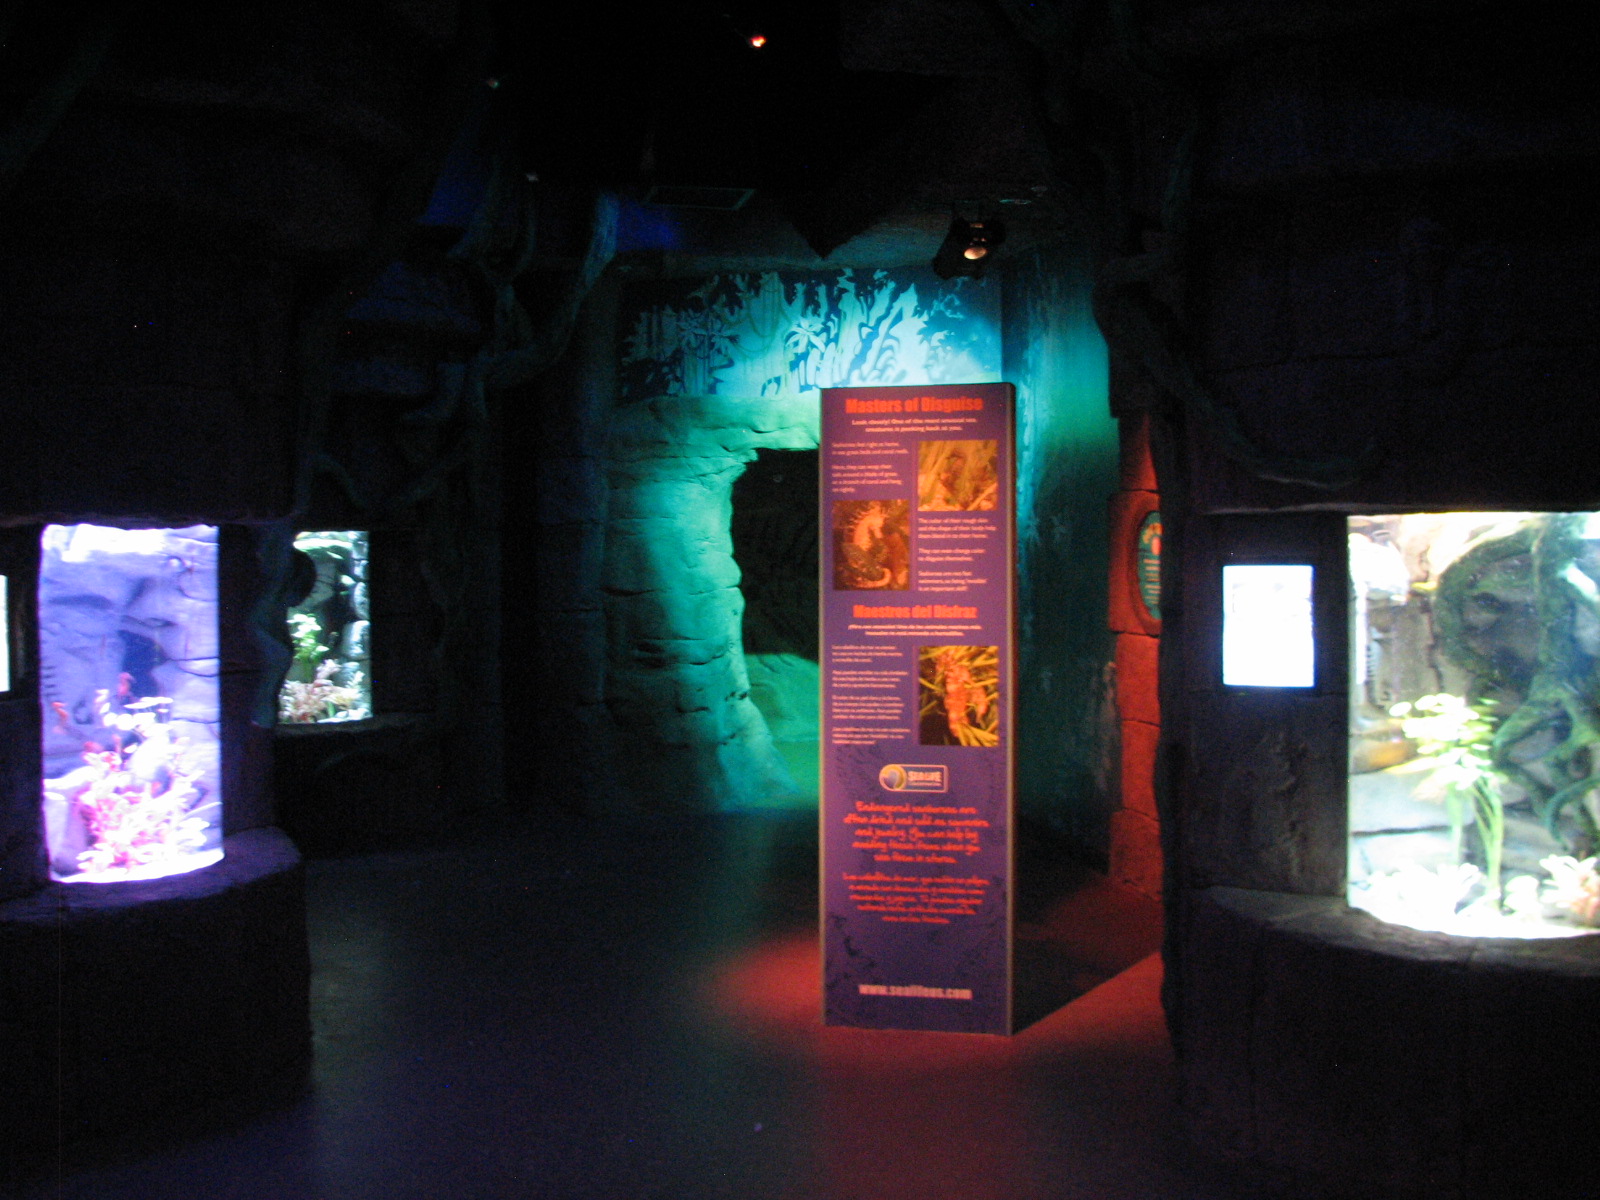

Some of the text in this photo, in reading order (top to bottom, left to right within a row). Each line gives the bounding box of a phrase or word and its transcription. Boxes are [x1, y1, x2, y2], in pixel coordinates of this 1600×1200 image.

[846, 396, 983, 413] Masters of Disguise
[853, 605, 977, 618] Maestros del Disfraz
